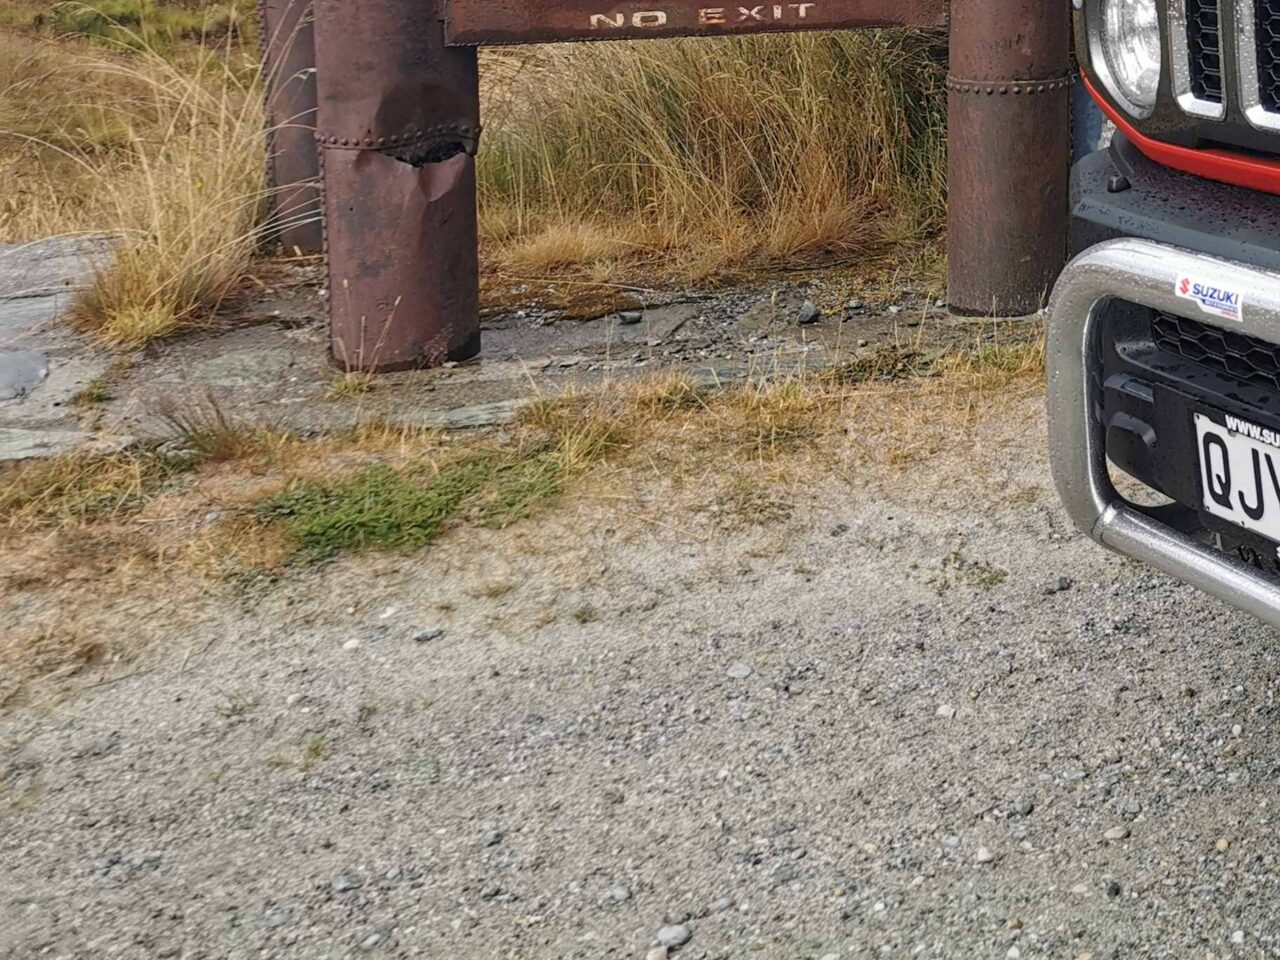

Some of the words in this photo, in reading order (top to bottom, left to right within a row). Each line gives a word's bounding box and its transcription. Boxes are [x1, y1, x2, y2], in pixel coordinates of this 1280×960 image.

[590, 10, 667, 27] NO
[700, 3, 814, 24] EXIT
[1192, 283, 1239, 305] SUZUKI
